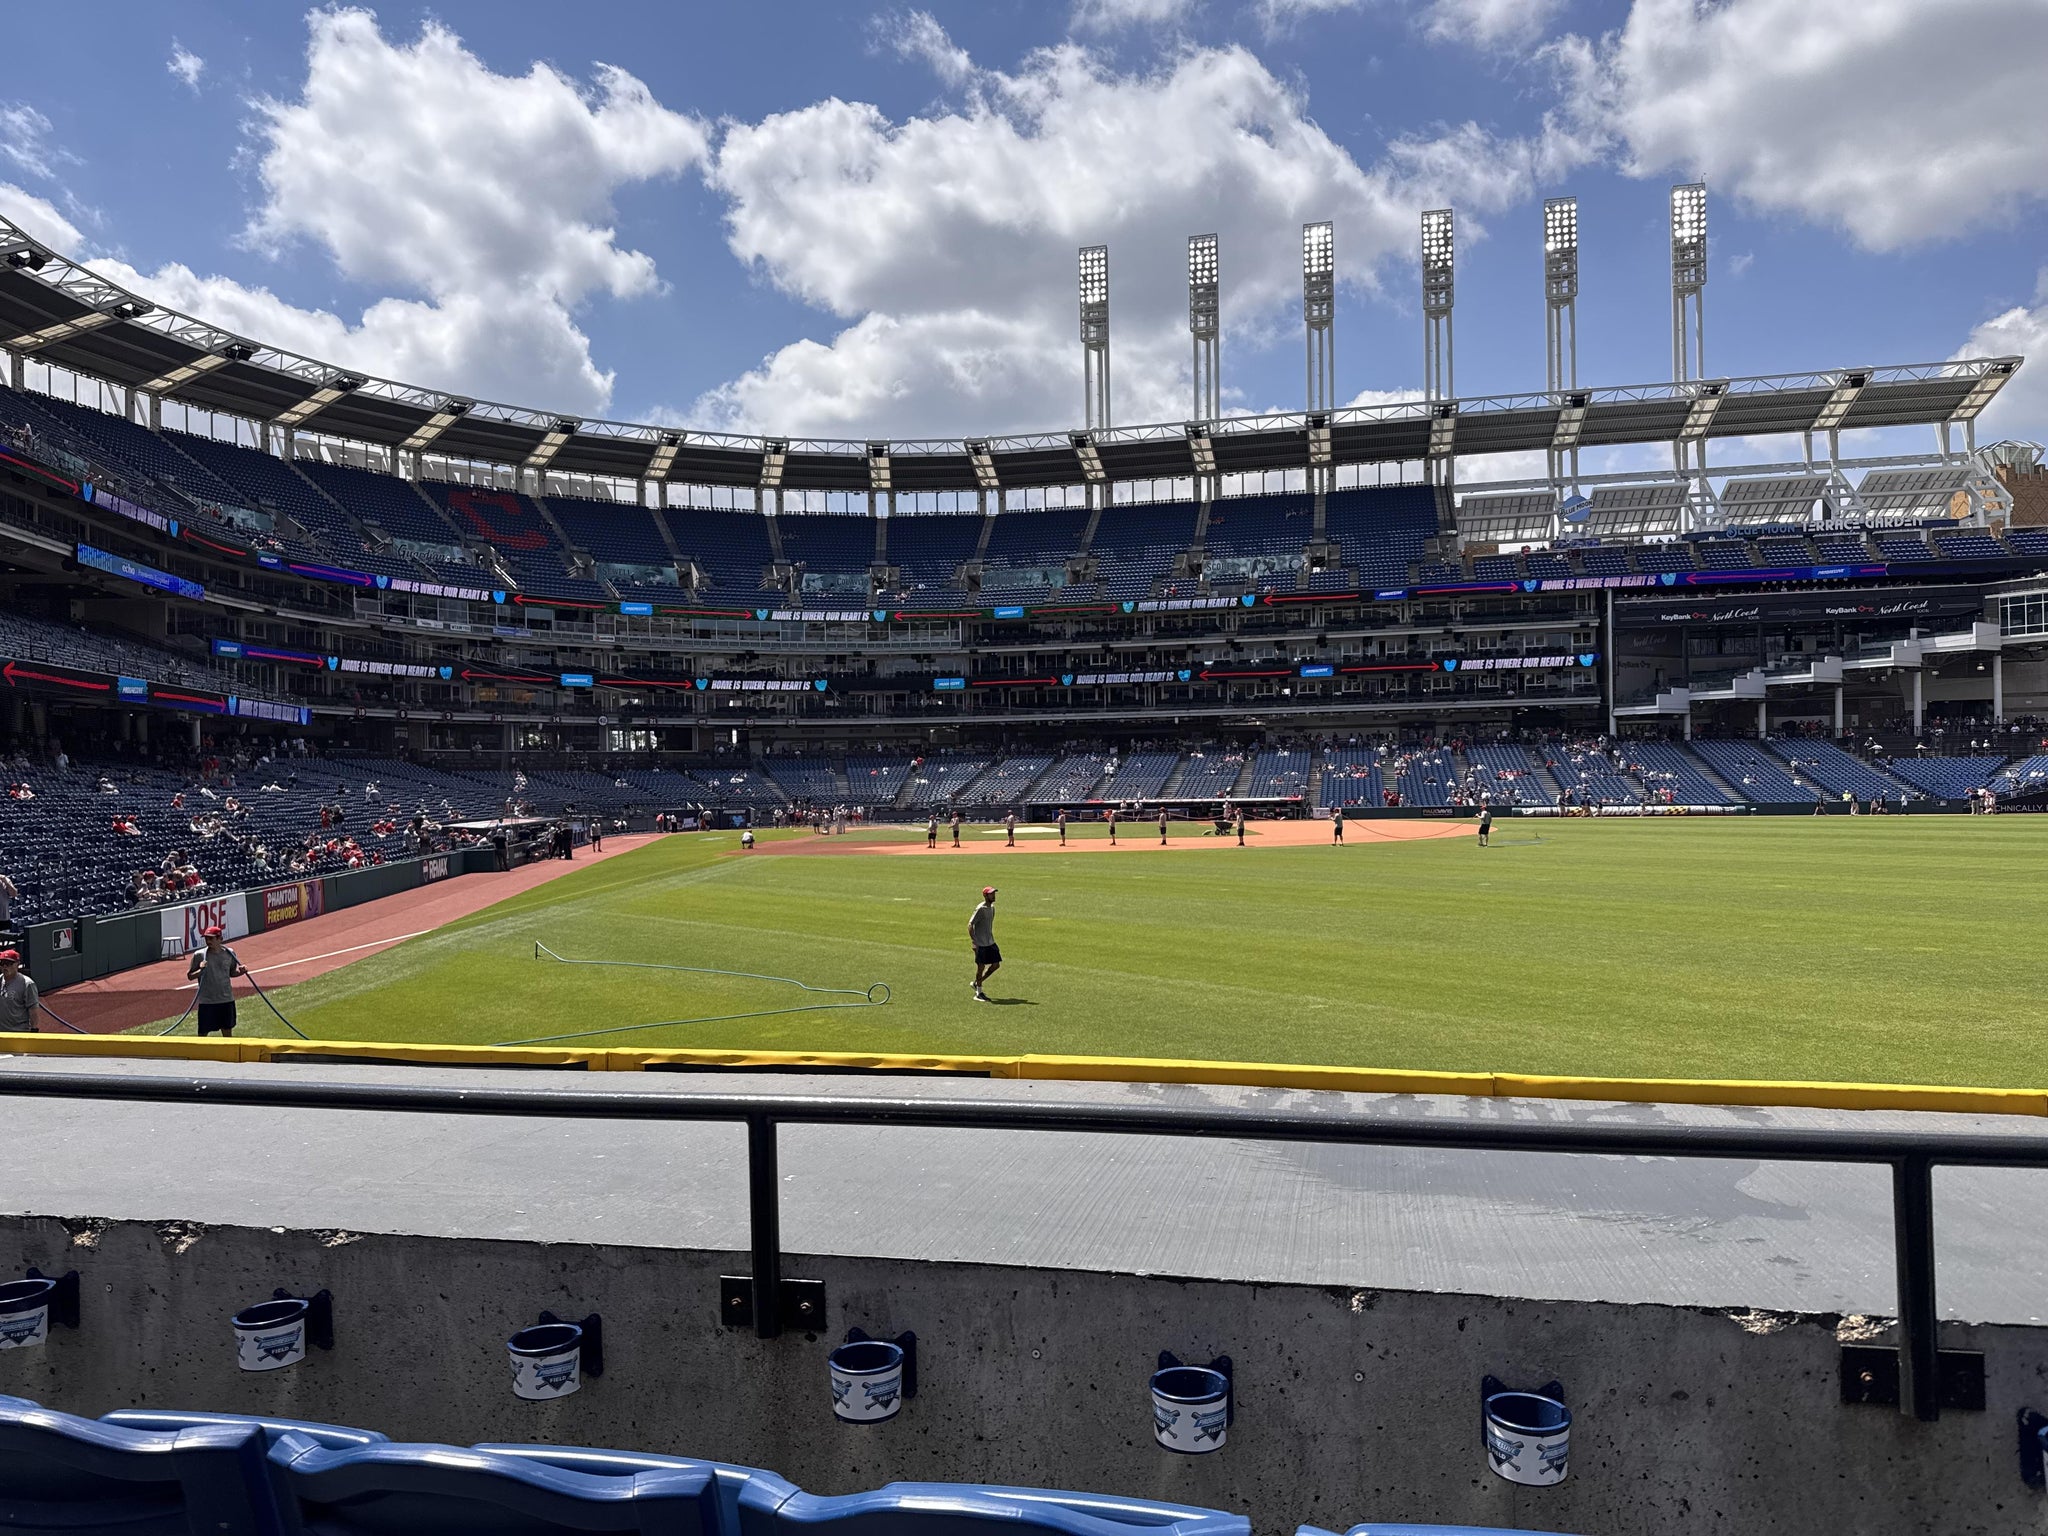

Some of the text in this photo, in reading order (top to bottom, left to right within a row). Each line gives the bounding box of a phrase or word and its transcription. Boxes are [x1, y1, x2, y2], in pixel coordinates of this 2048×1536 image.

[1576, 500, 1593, 510] MOON
[1725, 516, 1923, 538] BLUE MOON TERRACE GARDEN
[397, 544, 448, 562] Guardian
[1541, 575, 1656, 590] HOME IS WHERE OUR HEART IS
[391, 578, 489, 601] HOME IS WHERE OUR HEART IS
[1137, 597, 1237, 611] HOME IS WHERE OUR HEART IS
[1825, 607, 1857, 615] KeyBank
[1874, 603, 1902, 615] North
[772, 610, 870, 620] HOME IS WHERE OUR HEART IS
[1661, 613, 1691, 621] KeyBank
[1707, 609, 1735, 622] North
[341, 659, 436, 677] HOME IS WHERE OUR HEART IS
[1460, 656, 1574, 670] HOME IS WHERE OUR HEART IS
[1076, 672, 1174, 684] HOME IS WHERE OUR HEART IS
[711, 680, 811, 690] HOME IS WHERE OUR HEART IS
[1995, 804, 2044, 812] CHNICALLY,
[267, 887, 298, 908] PHANTOM
[267, 905, 298, 924] FIREWORKS
[184, 899, 227, 951] ROSE
[271, 1346, 290, 1354] FIELD
[550, 1375, 566, 1383] FIELD
[879, 1393, 894, 1402] FIELD
